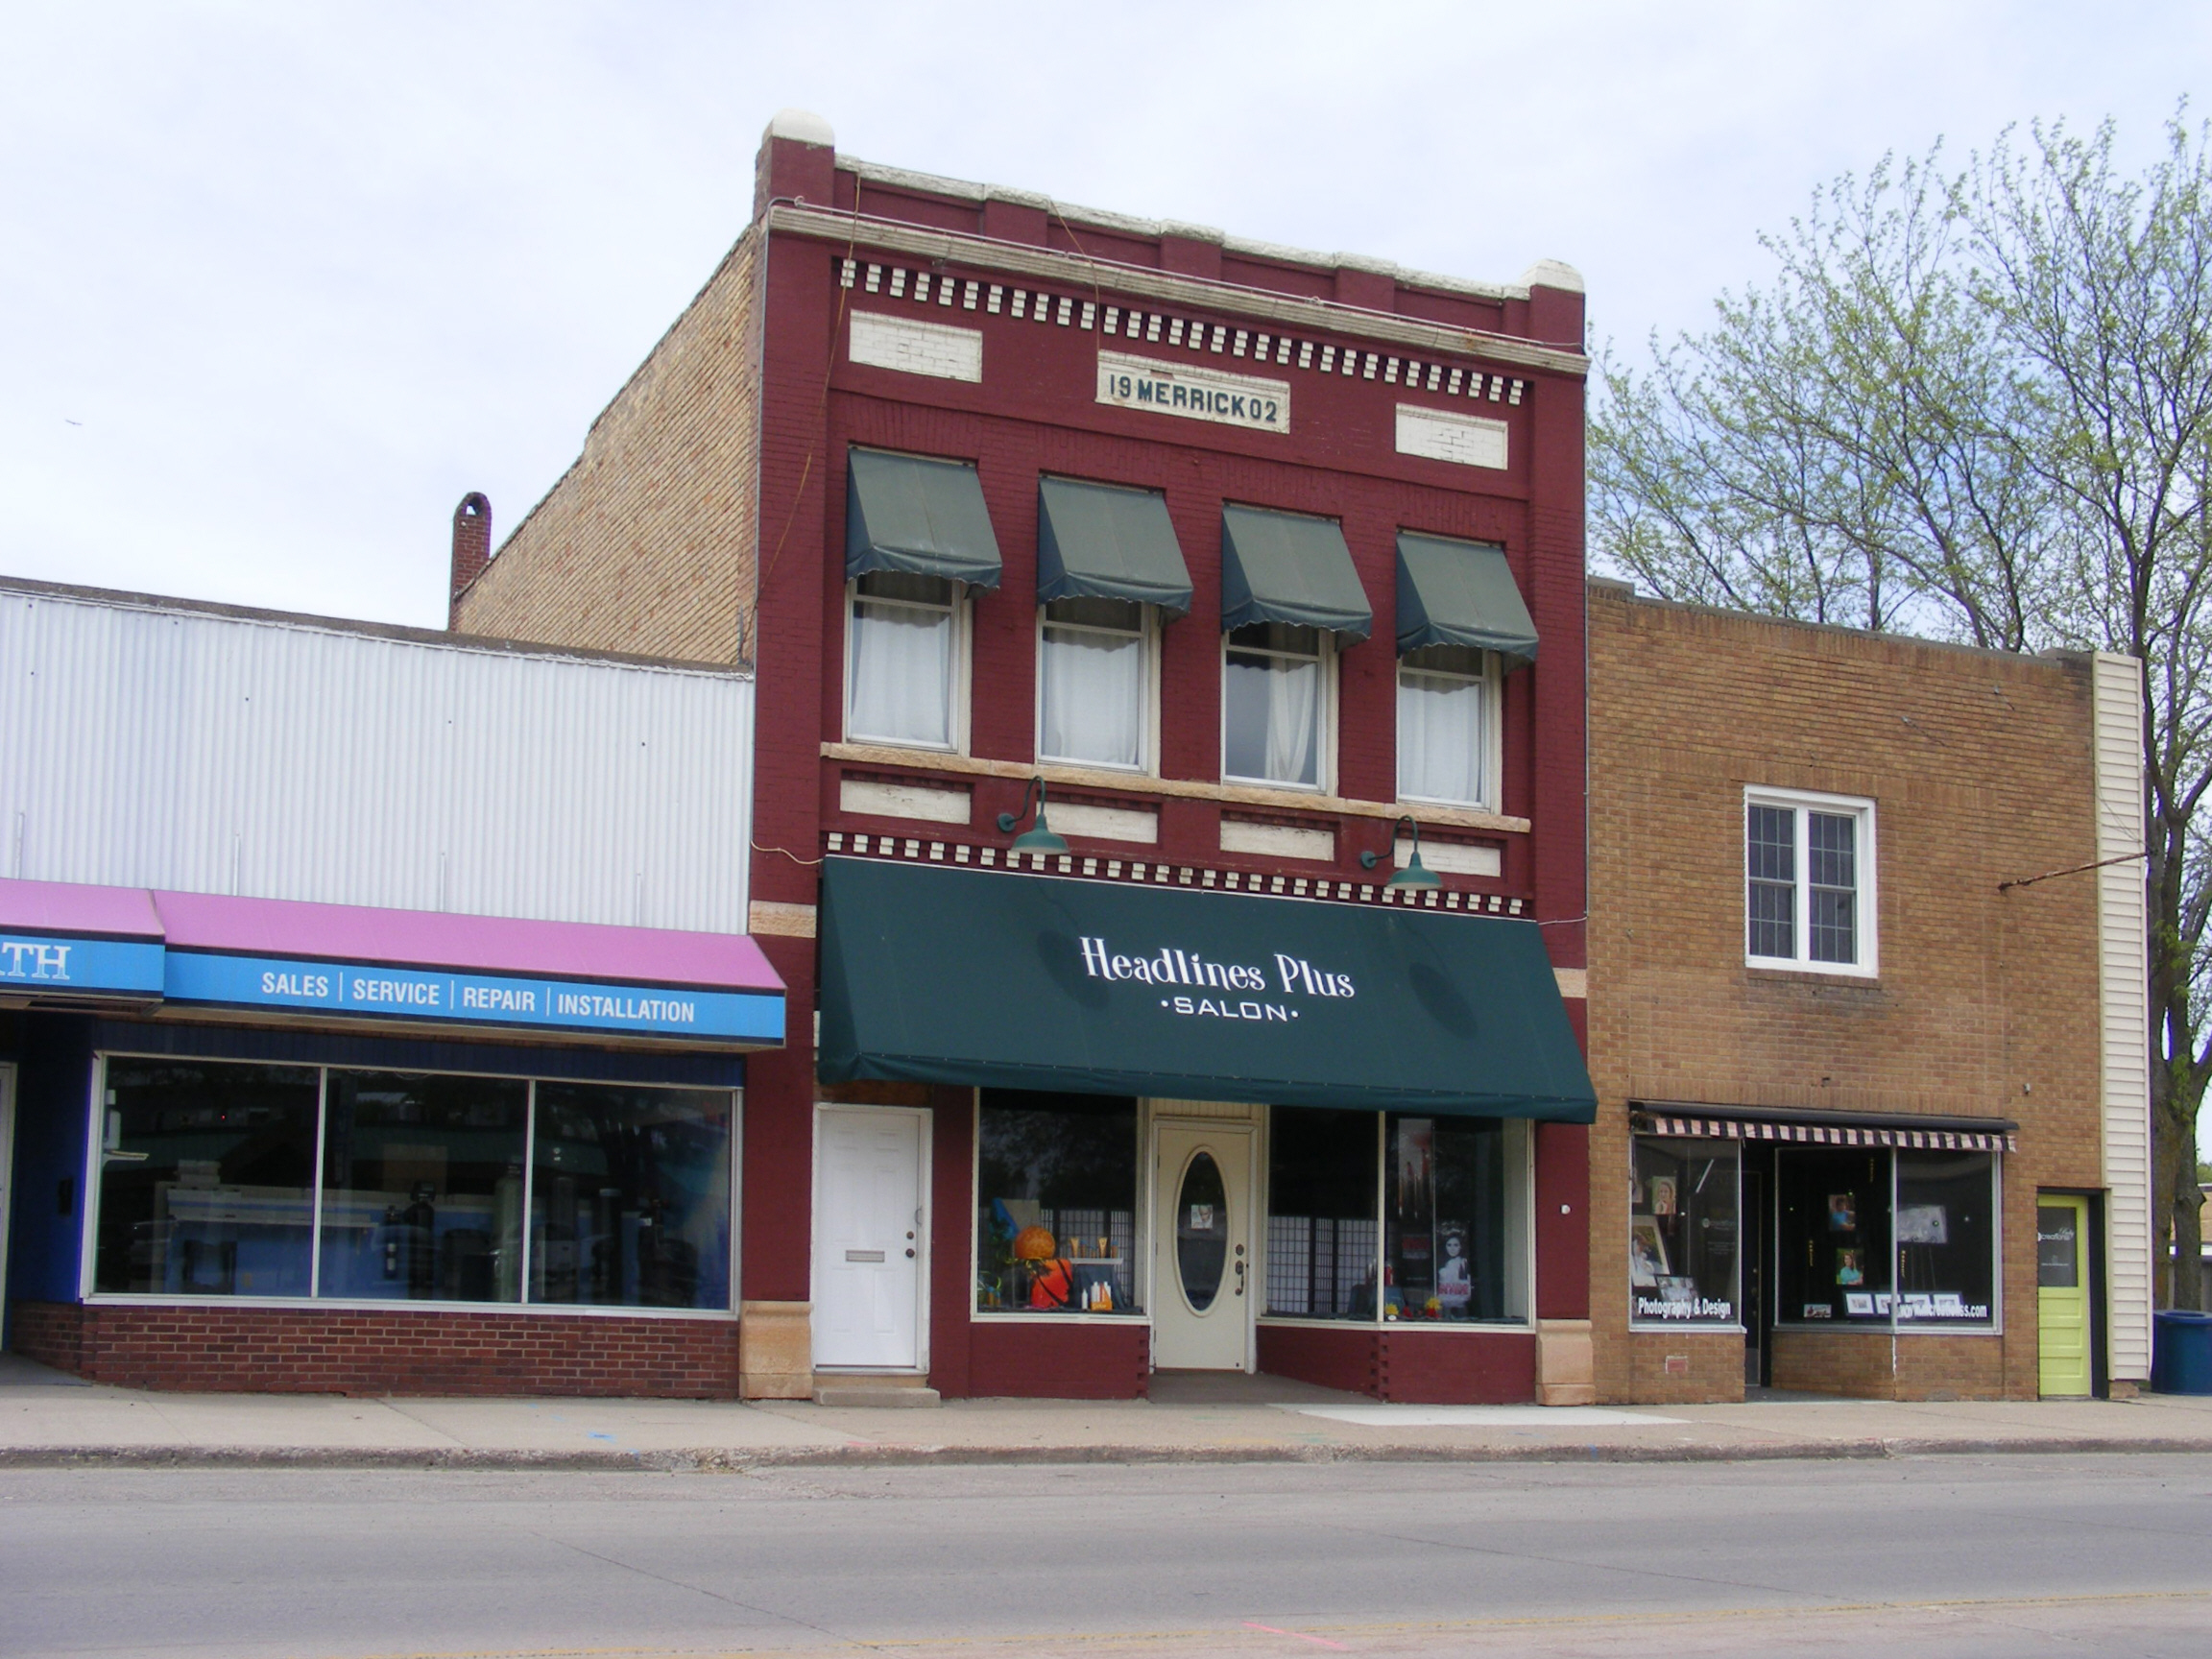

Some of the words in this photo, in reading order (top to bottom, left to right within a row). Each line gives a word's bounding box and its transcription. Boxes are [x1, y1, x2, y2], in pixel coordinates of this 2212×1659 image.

[1137, 379, 1246, 418] MERRICK
[0, 942, 72, 980] TH
[1078, 936, 1266, 992] Headlines
[1273, 951, 1356, 998] Plus
[261, 972, 329, 998] SALES
[352, 978, 441, 1005] SERVICE
[463, 986, 536, 1012] REPAIR
[558, 993, 694, 1022] INSTALLATION
[1173, 996, 1287, 1022] SALON
[1638, 1297, 1691, 1319] Photography
[1694, 1297, 1701, 1315] &
[1702, 1298, 1731, 1320] Design
